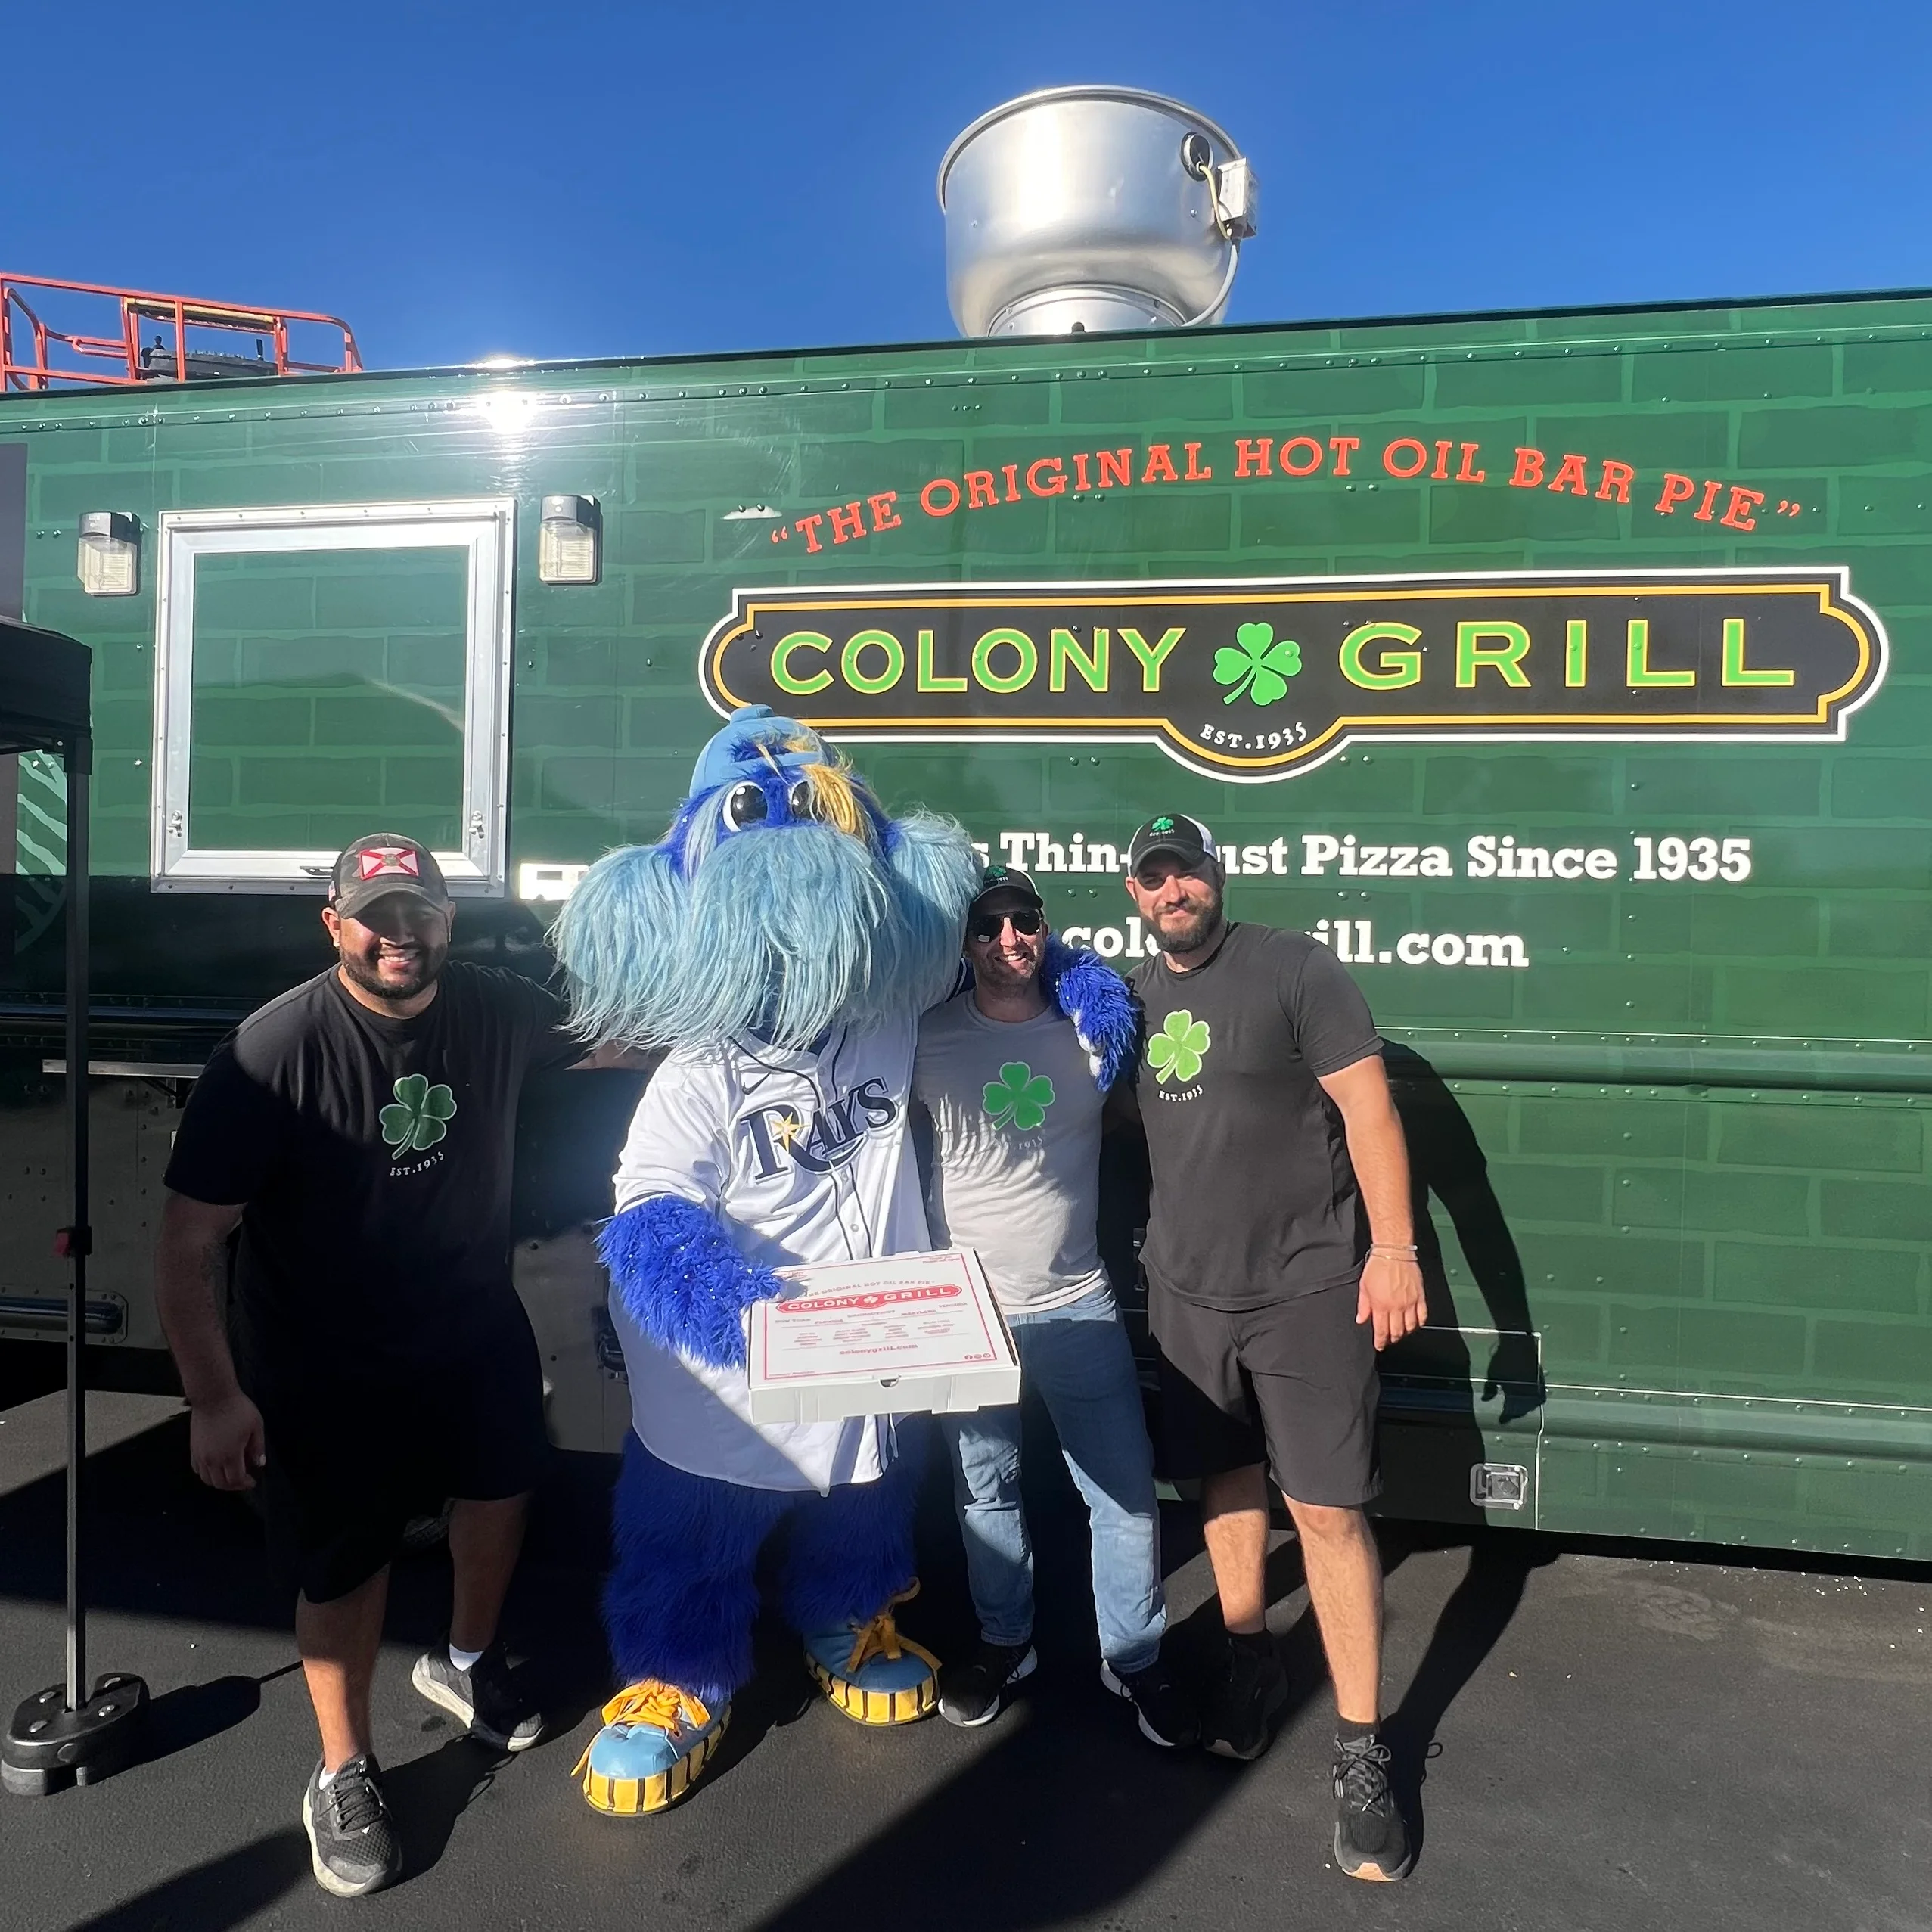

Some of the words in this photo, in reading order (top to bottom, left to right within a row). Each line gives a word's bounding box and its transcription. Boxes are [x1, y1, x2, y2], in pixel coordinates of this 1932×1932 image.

[921, 445, 1211, 517] ORIGINAL
[1235, 437, 1359, 477] HOT
[1383, 439, 1484, 483] OIL
[1510, 448, 1634, 504] BAR
[770, 627, 1186, 694] COLONY
[1339, 618, 1795, 691] GRILL
[1301, 834, 1453, 877] Pizza
[1467, 835, 1617, 879] Since
[1633, 837, 1751, 881] 1935
[787, 1296, 860, 1310] COLONY
[883, 1287, 952, 1301] GRILL
